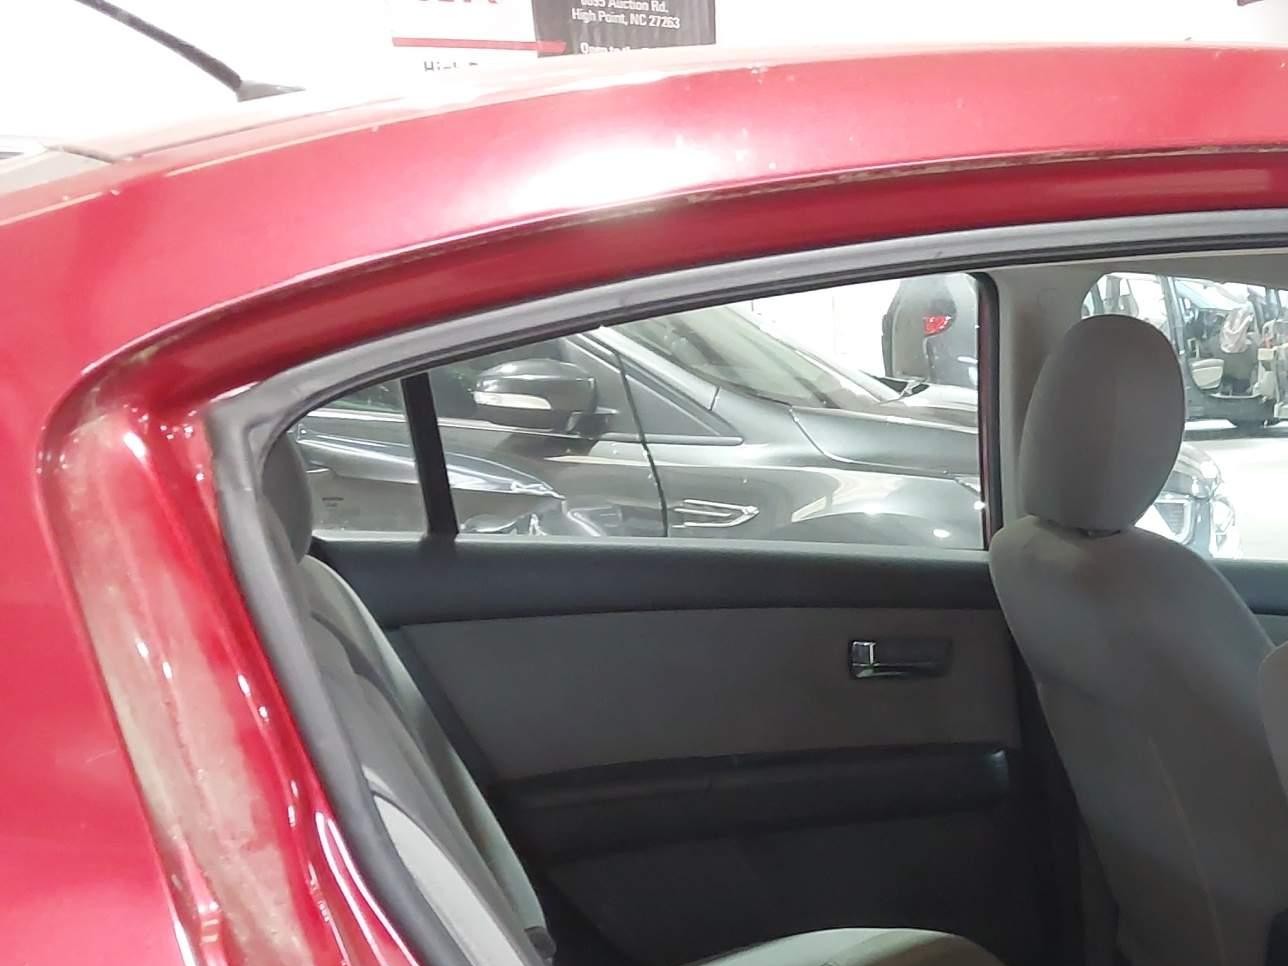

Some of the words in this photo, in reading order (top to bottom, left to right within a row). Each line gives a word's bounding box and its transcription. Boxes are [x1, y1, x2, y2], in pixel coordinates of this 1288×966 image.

[607, 0, 649, 11] Auction
[571, 7, 596, 23] High
[598, 10, 628, 26] Point,
[629, 13, 647, 26] NC
[648, 15, 681, 29] 27263
